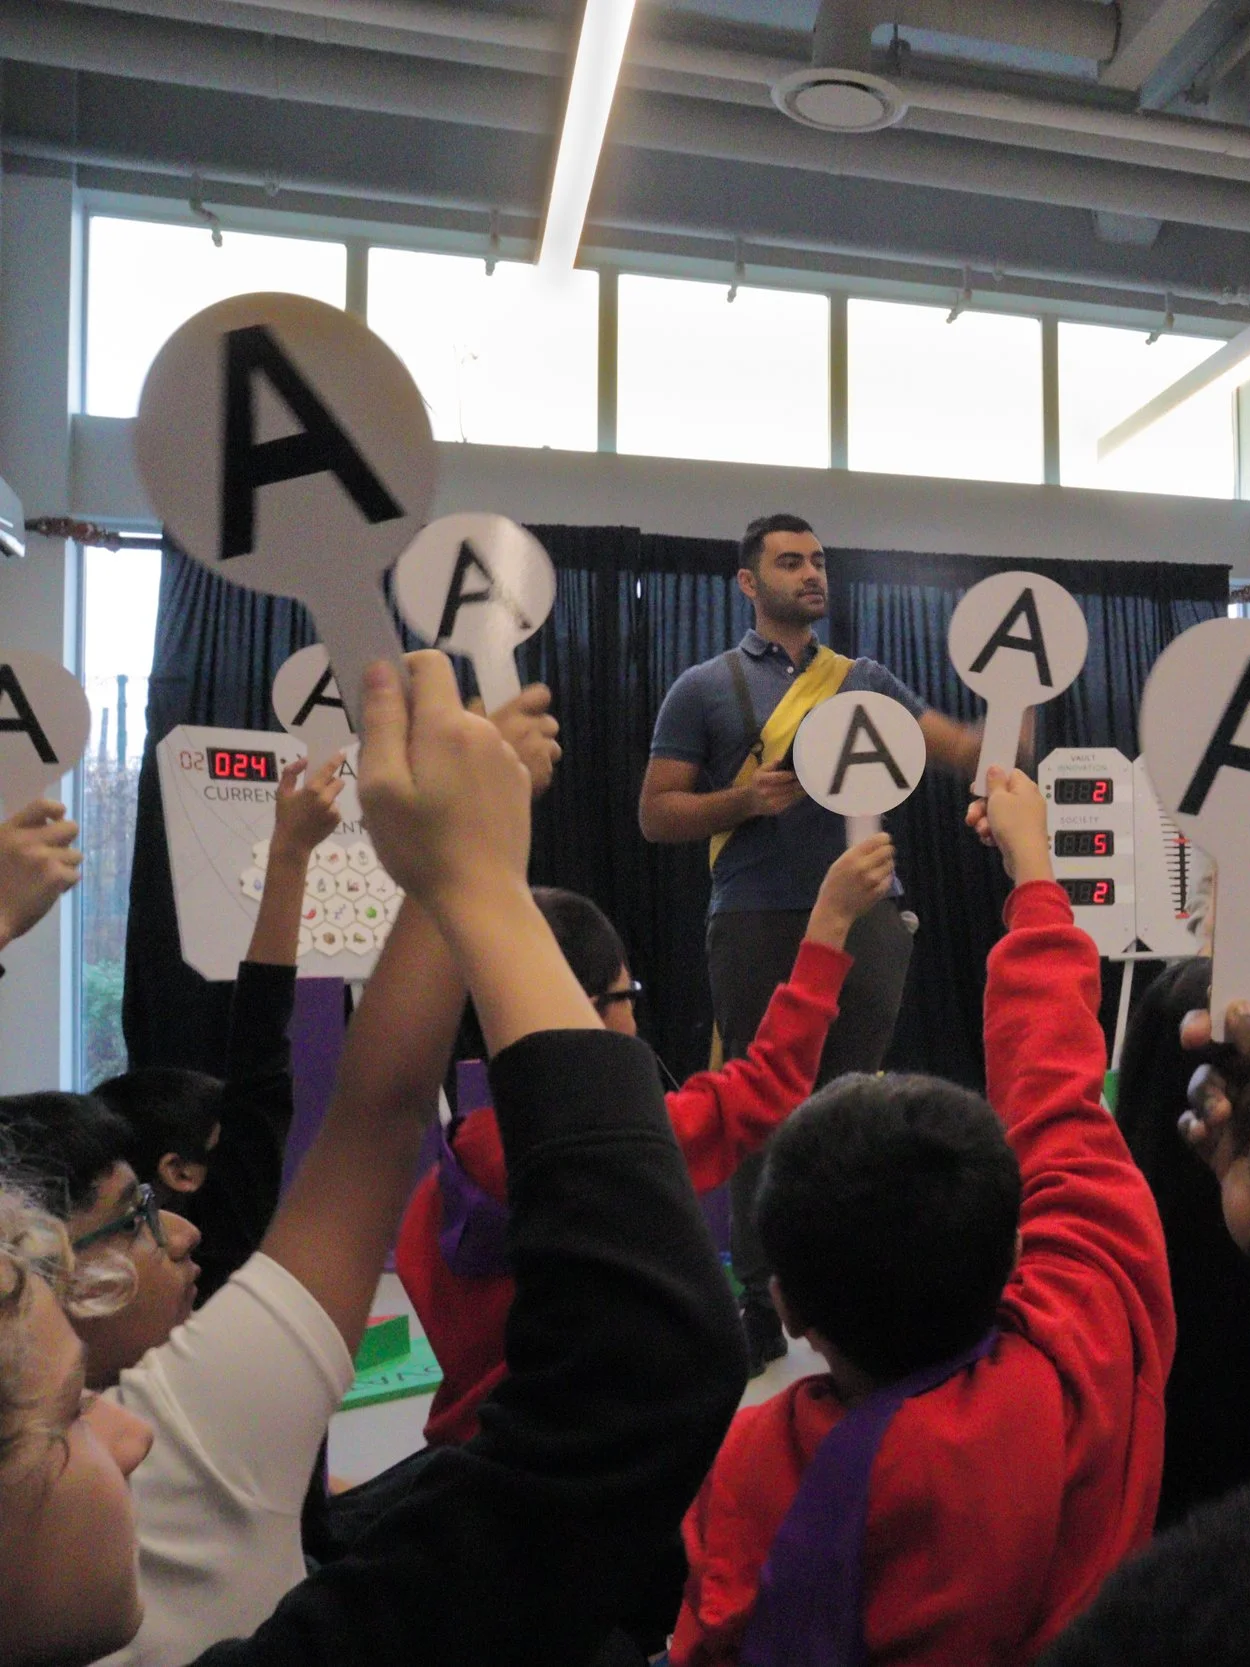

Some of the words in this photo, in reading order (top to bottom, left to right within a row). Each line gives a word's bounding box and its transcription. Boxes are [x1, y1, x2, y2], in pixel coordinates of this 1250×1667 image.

[218, 324, 404, 560] A
[436, 540, 531, 646] A
[968, 587, 1054, 688] A
[828, 703, 910, 796] A
[1070, 754, 1095, 763] VAULT
[214, 751, 267, 778] 024
[1092, 782, 1107, 802] 2
[1060, 816, 1099, 824] SOCIETY
[1094, 833, 1107, 855] 5
[1092, 882, 1108, 904] 2
